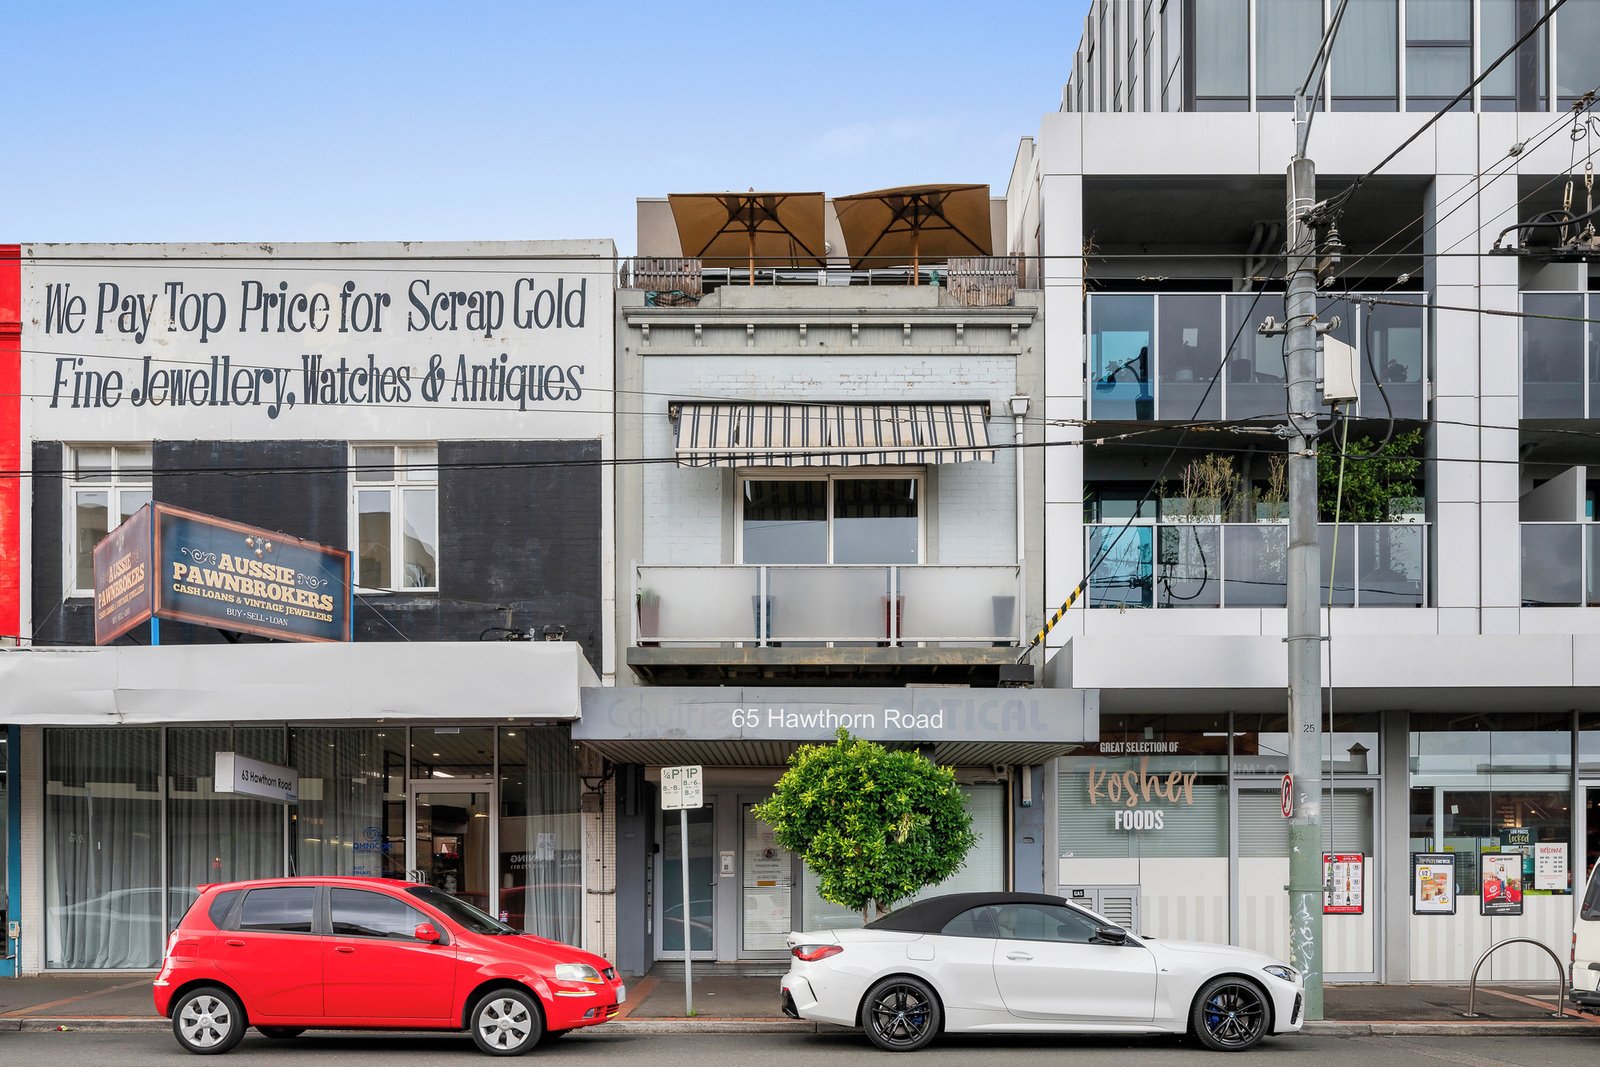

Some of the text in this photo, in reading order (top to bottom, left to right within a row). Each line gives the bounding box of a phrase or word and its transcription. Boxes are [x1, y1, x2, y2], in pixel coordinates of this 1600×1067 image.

[46, 277, 587, 345] We Pay Top Price for Scrap Gold
[49, 353, 585, 420] Fine Jewellery, Watches & Antiques
[108, 552, 132, 583] AUSSIE
[218, 553, 295, 585] AUSSIE
[172, 562, 334, 612] PAWNBROKERS
[173, 583, 333, 622] CASH LOANS & VINTAGE JEWELLERS
[226, 607, 289, 626] BUY SELL LOAN
[731, 708, 943, 729] 65 Hawthorn Road
[1303, 724, 1316, 733] 25
[1100, 741, 1179, 753] GREAT SELECTION OF
[241, 769, 292, 791] 63 Hawthorn Road
[686, 767, 698, 779] 1P
[1114, 809, 1165, 831] FOODS
